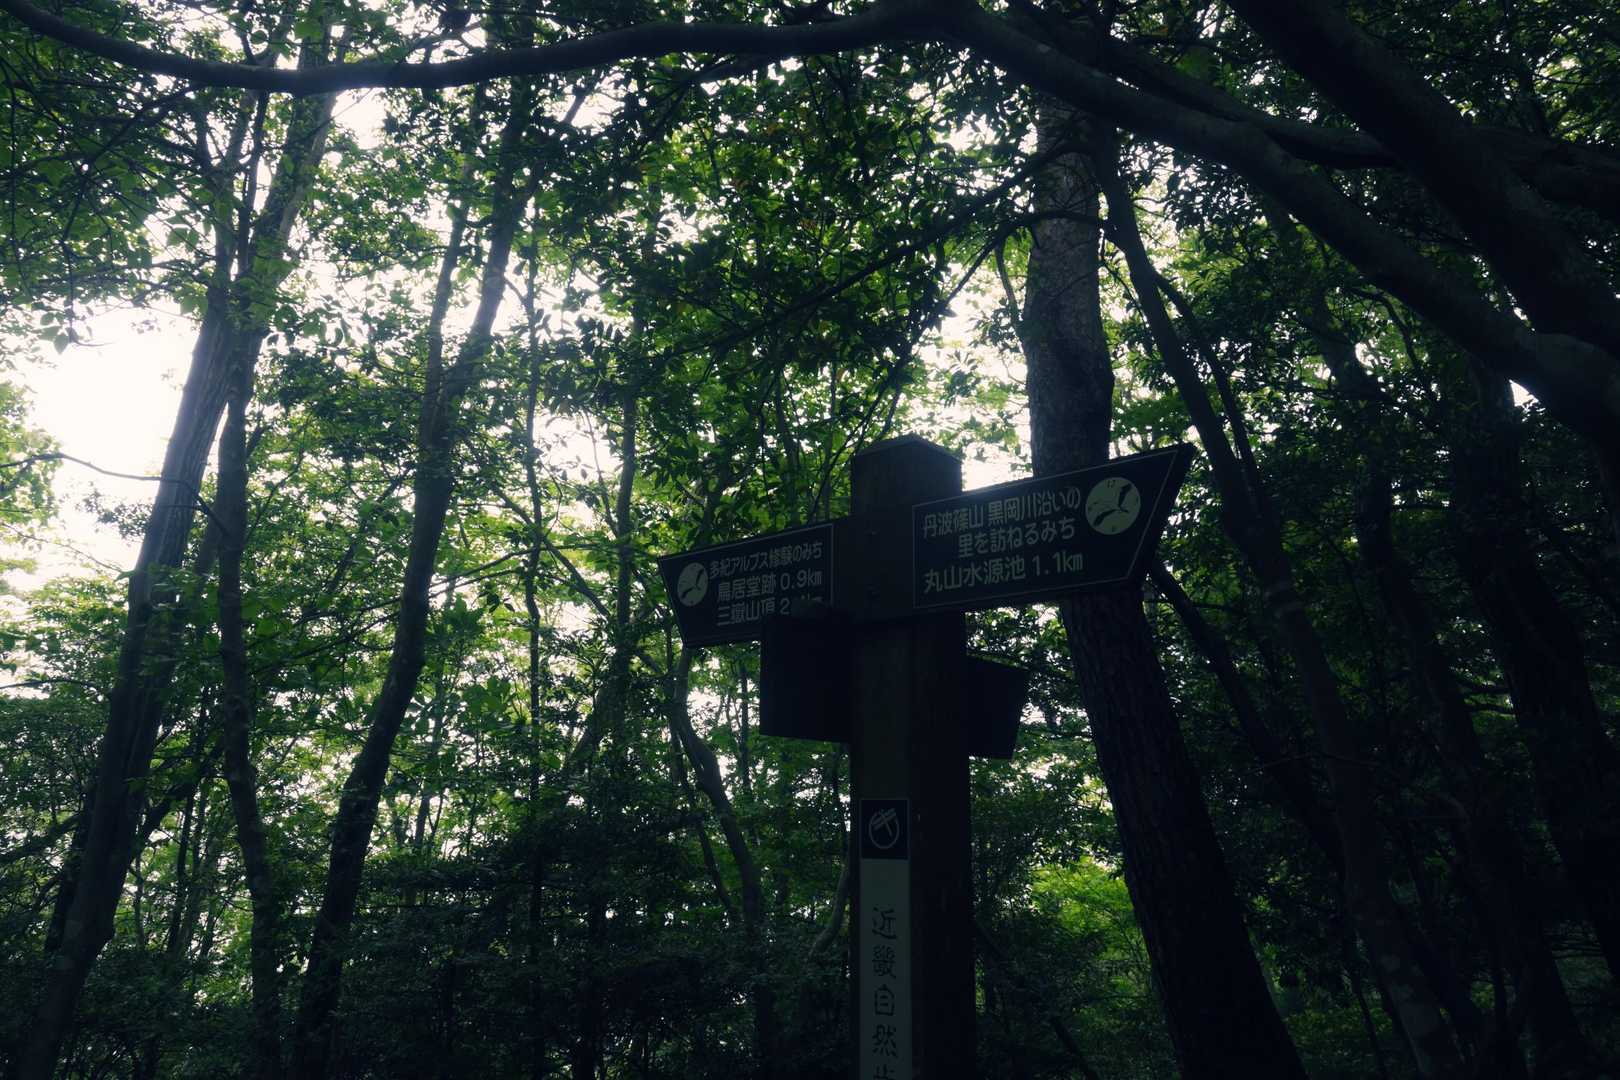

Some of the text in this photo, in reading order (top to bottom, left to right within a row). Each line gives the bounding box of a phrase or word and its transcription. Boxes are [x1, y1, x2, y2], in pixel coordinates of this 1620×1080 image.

[923, 486, 1081, 539] 丹波篠山 黒岡川沿いの
[958, 516, 1076, 558] 里を訪ねるみち
[717, 568, 823, 603] 鳥居堂跡 0.9km
[924, 550, 1083, 594] 丸山水源池 1.1km
